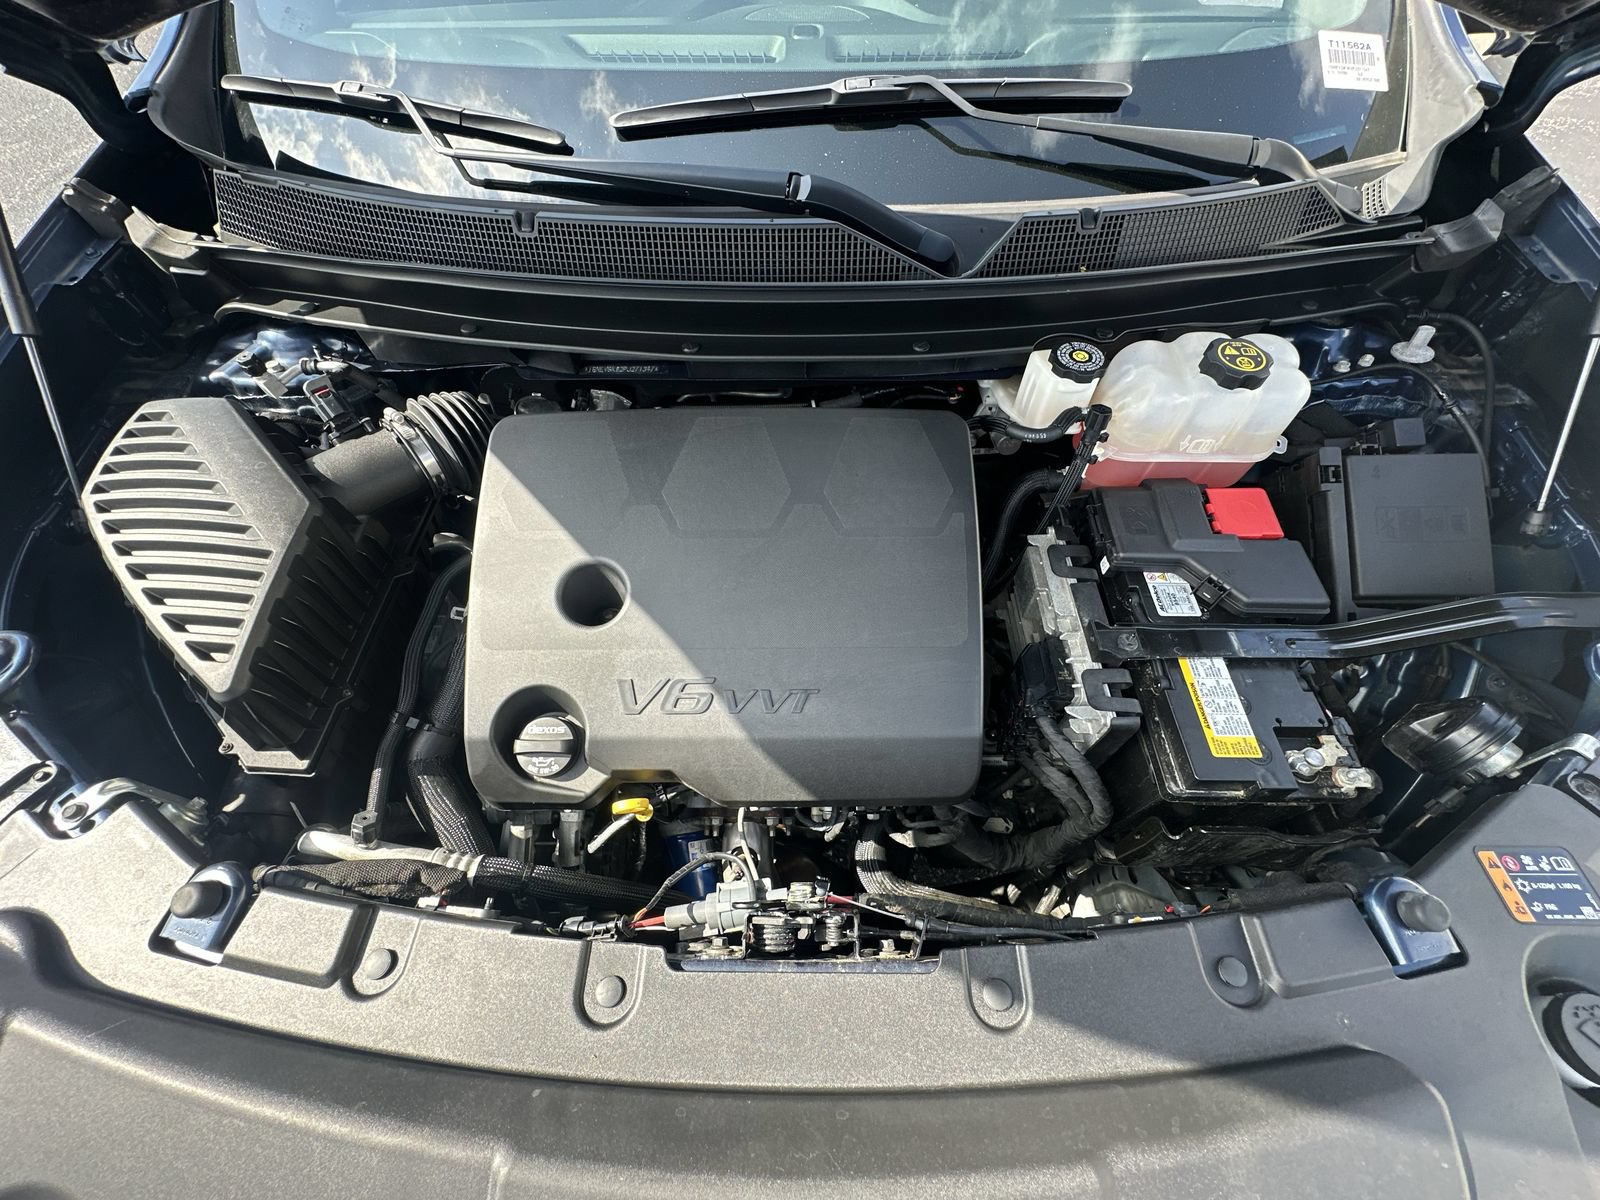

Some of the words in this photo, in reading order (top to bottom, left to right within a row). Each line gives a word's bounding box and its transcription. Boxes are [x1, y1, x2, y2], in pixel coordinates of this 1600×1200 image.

[1328, 40, 1372, 51] T11562A
[616, 677, 717, 715] V6
[722, 688, 820, 715] VVT
[527, 725, 566, 734] dexos
